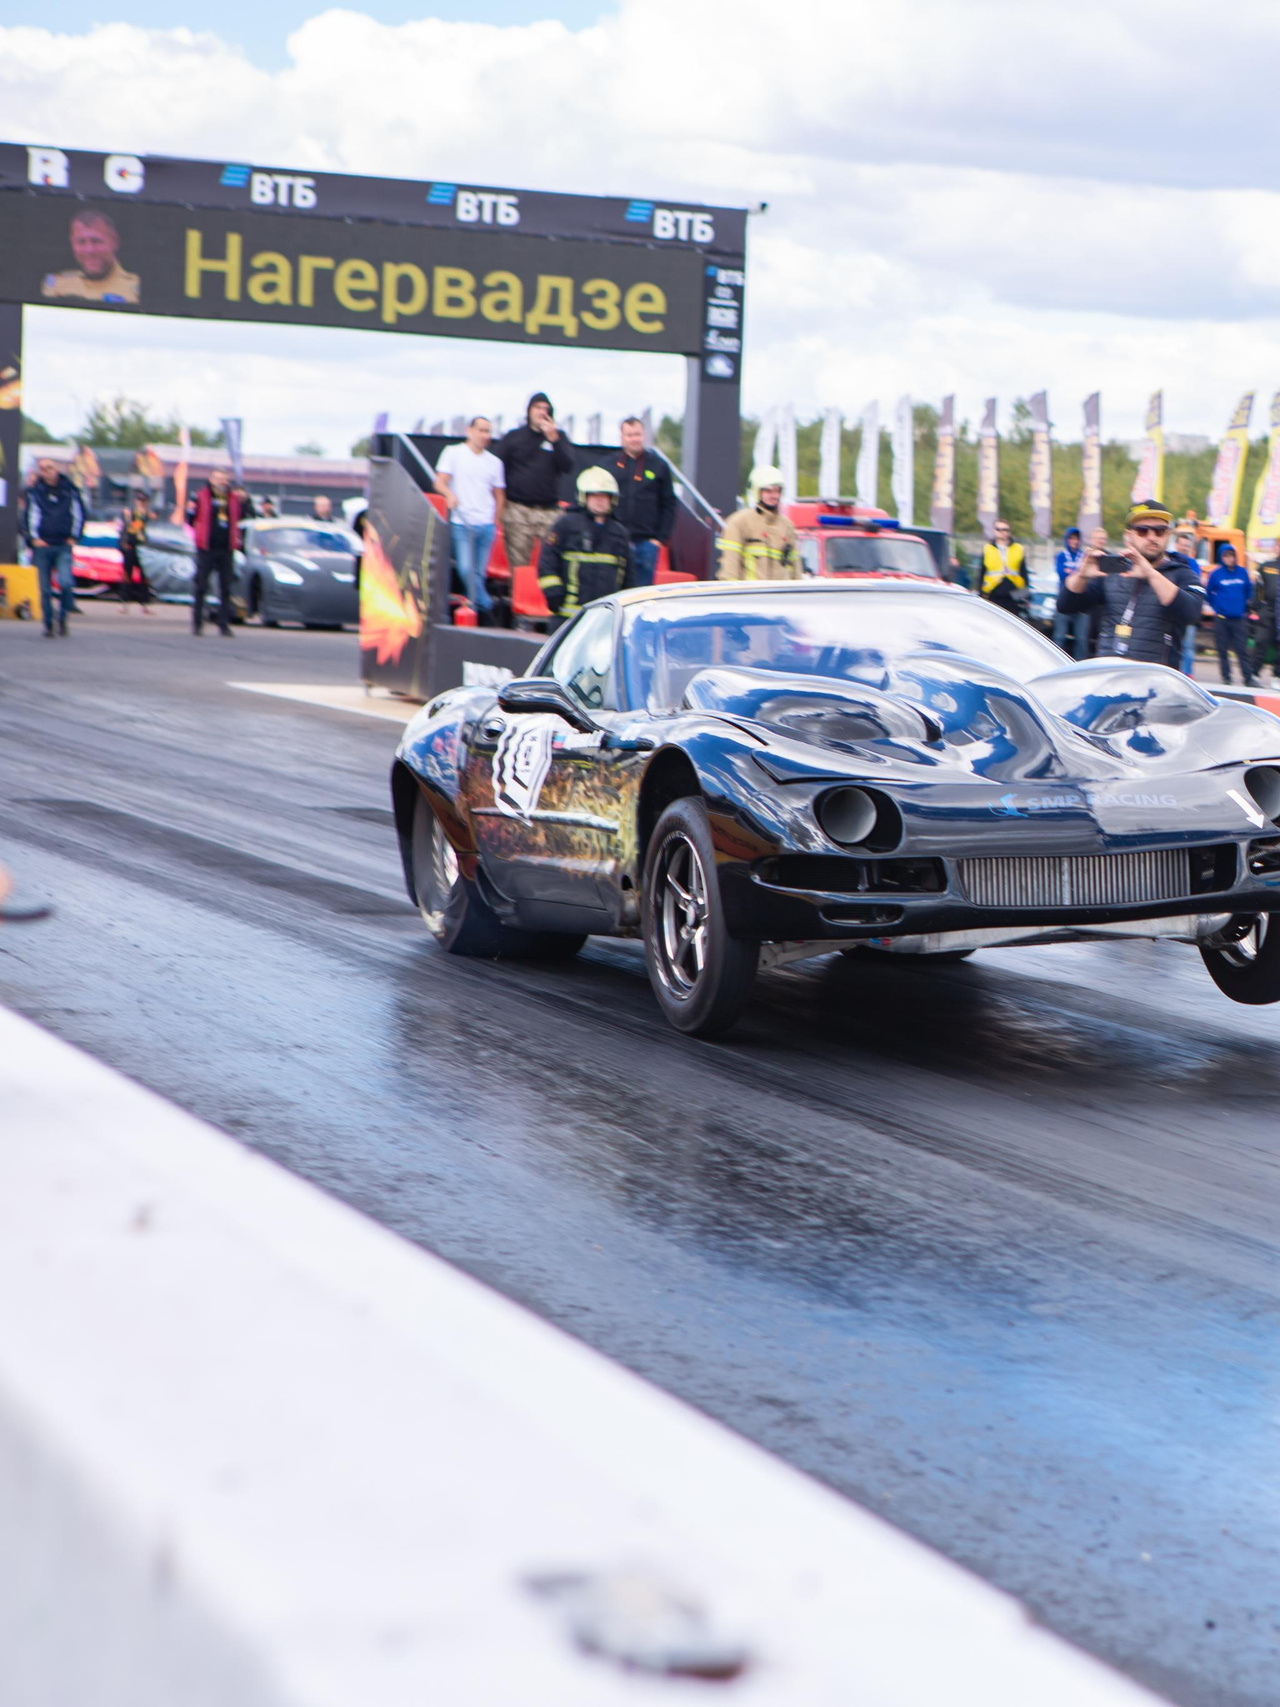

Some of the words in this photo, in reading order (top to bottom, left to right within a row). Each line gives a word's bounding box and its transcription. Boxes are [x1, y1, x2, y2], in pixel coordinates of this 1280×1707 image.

[251, 172, 318, 209] ВТБ
[456, 190, 520, 226] ВТБ
[653, 208, 715, 243] ВТБ
[184, 228, 668, 338] Нагервадзе
[1027, 795, 1081, 811] SMP
[1087, 794, 1178, 807] RACING
